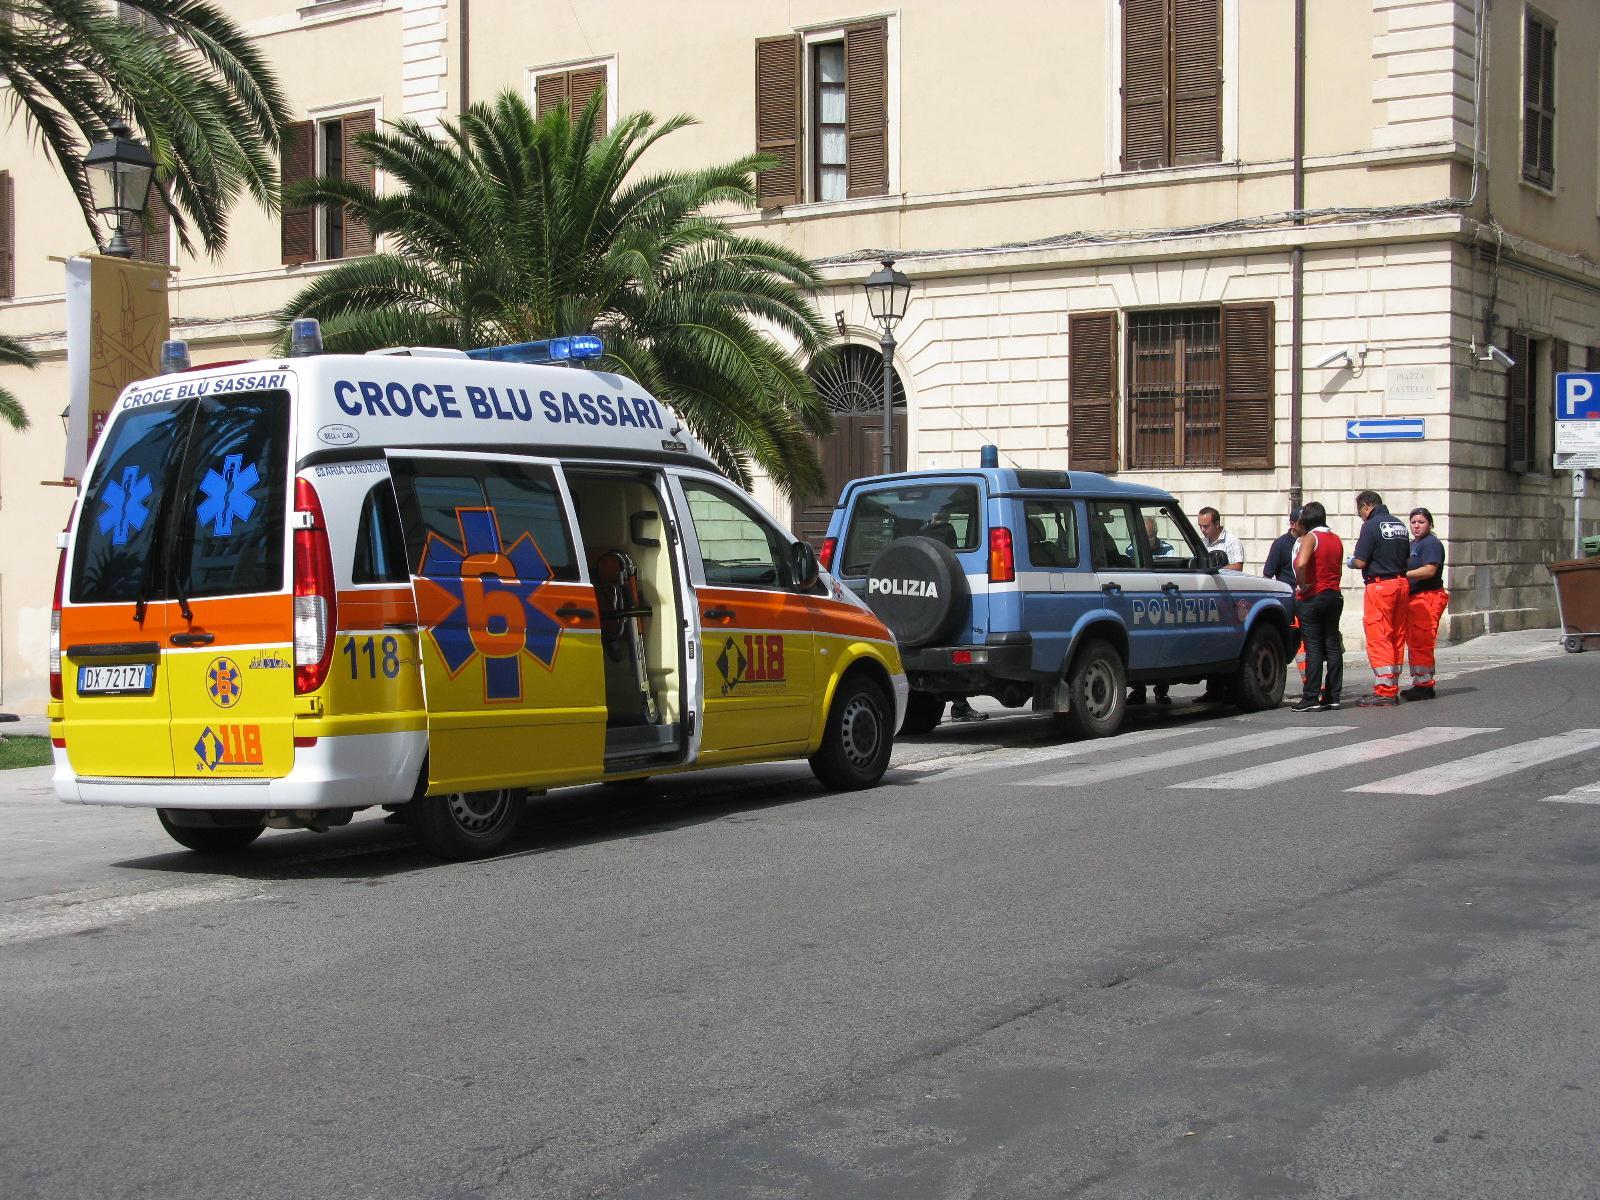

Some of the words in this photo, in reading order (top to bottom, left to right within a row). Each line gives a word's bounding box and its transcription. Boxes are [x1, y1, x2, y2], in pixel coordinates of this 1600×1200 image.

[122, 387, 173, 409] CROCE
[177, 381, 209, 398] BLU
[213, 374, 286, 393] SASSARI
[334, 380, 462, 419] CROCE
[465, 385, 533, 422] BLU
[539, 389, 664, 430] SASSARI
[1566, 379, 1592, 414] P
[868, 578, 939, 598] POLIZIA
[1132, 598, 1220, 624] POLIZIA
[343, 635, 400, 679] 118
[744, 635, 785, 680] 118
[86, 669, 101, 688] DX
[106, 667, 144, 688] 721ZY
[217, 670, 231, 695] 6
[219, 725, 263, 763] 118
